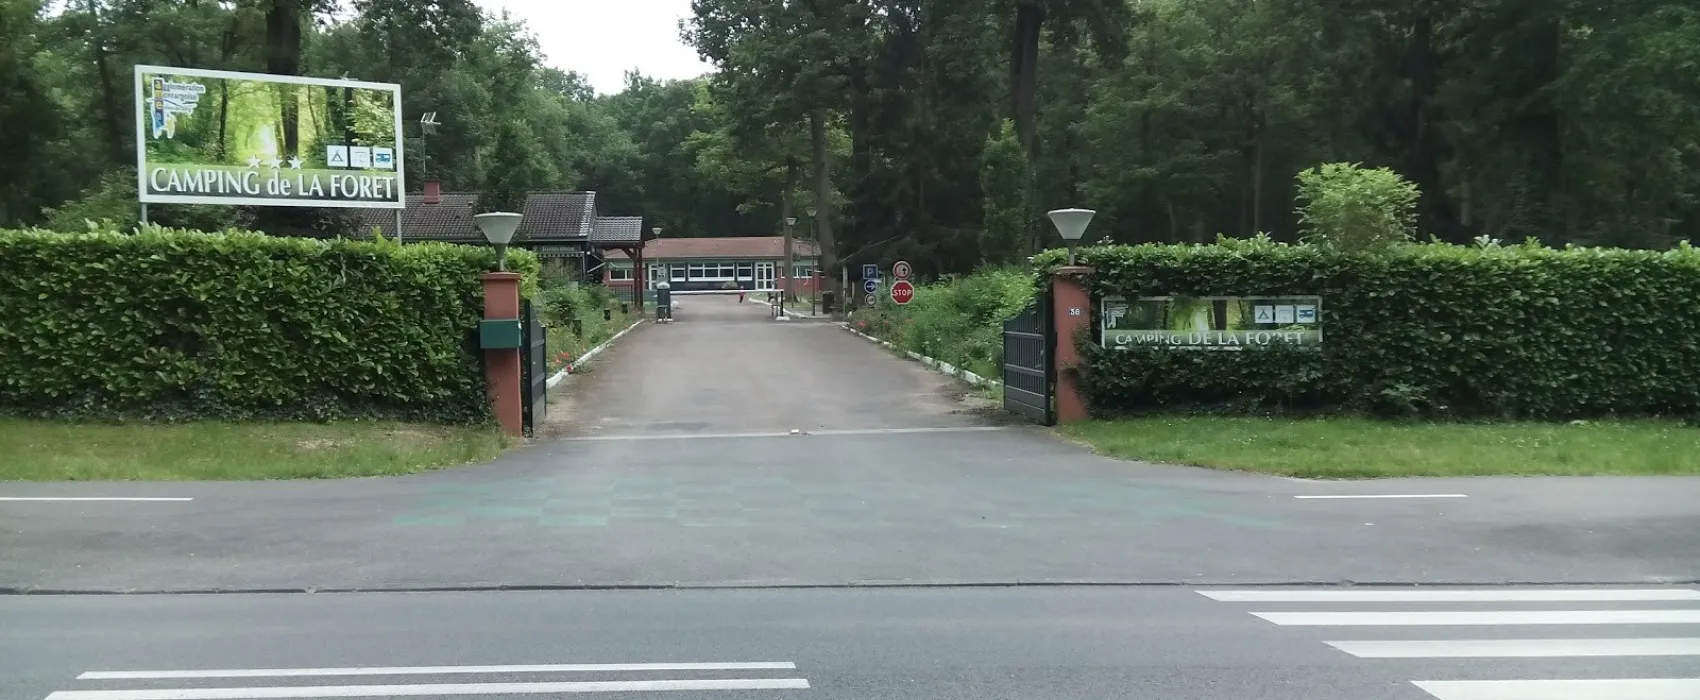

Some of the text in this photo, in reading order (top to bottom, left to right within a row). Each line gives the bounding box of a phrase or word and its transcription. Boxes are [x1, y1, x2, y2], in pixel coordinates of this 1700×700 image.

[150, 167, 395, 199] CAMPING de LA FORET
[867, 268, 873, 276] P
[1188, 331, 1212, 345] DE
[1218, 331, 1240, 345] LA
